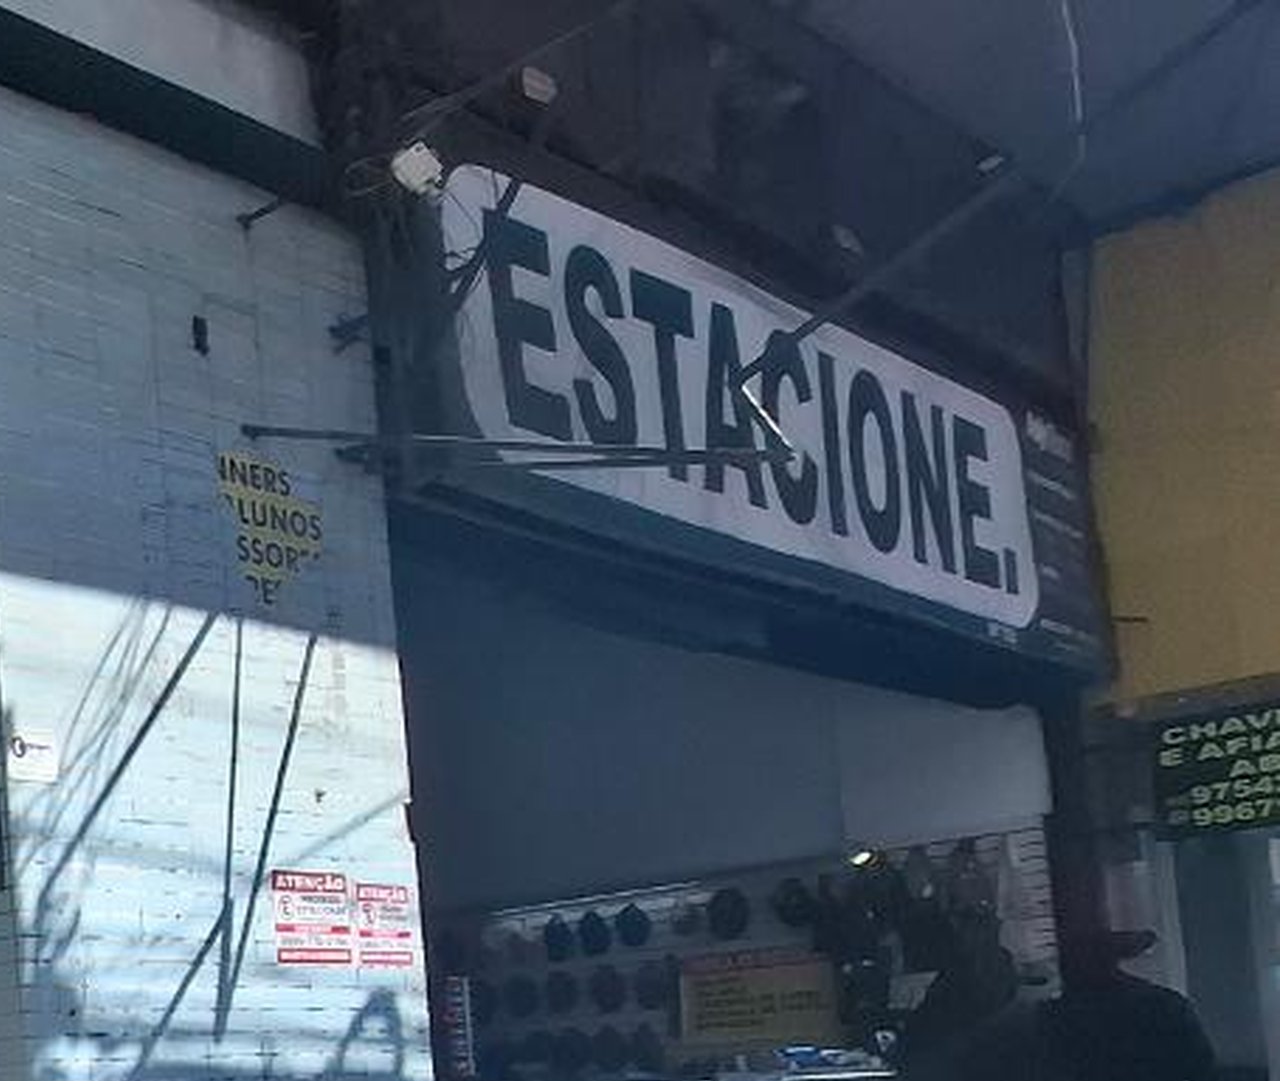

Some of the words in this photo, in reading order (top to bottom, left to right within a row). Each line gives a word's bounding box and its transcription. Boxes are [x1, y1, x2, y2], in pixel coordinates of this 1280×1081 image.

[483, 207, 1020, 595] ESTACIONE.
[220, 494, 322, 541] LUNOS
[1160, 748, 1184, 767] E
[1190, 774, 1280, 805] 9754
[1192, 799, 1280, 826] 9967
